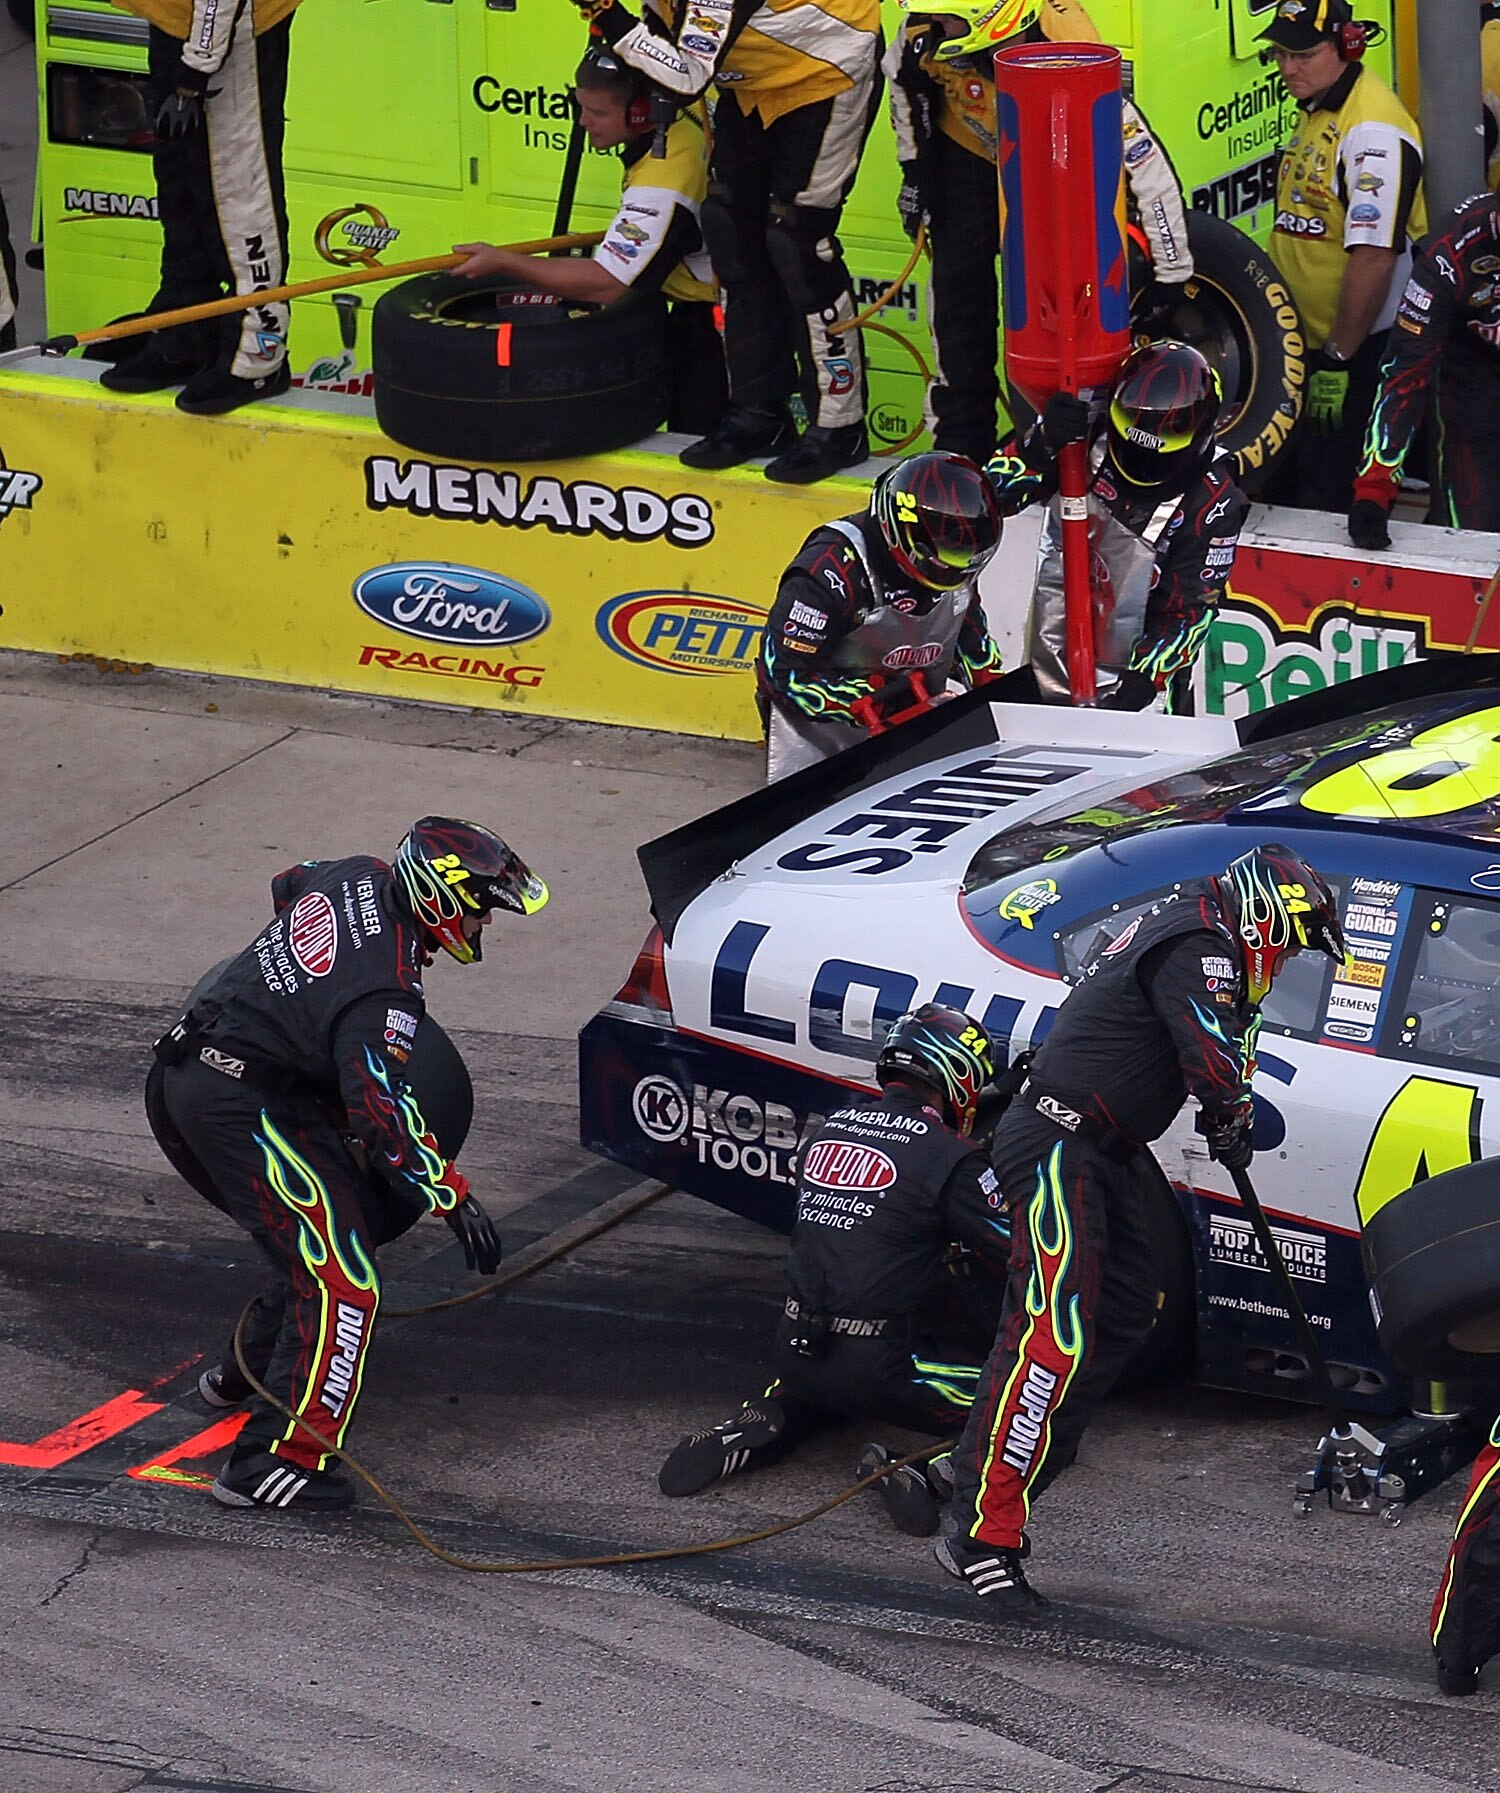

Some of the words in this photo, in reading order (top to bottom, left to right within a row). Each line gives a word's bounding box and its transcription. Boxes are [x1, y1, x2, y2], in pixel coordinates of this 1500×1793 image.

[341, 221, 401, 245] QUAKER
[347, 235, 389, 251] STATE
[244, 233, 282, 334] MEN
[877, 411, 908, 434] Serta
[368, 457, 715, 546] MENARDS
[896, 490, 919, 525] 24
[392, 572, 512, 636] Ford
[688, 607, 749, 624] RICHARD
[789, 608, 829, 631] GUARD
[357, 644, 546, 688] RACING
[430, 852, 473, 886] 24
[1017, 882, 1062, 906] QUAKER
[1278, 884, 1312, 915] 24
[1351, 876, 1401, 897] Hendrick
[356, 875, 382, 937] VERMEER
[1012, 893, 1050, 913] STATE
[1346, 902, 1387, 918] NATIONAL
[293, 893, 334, 971] DUPONT
[1344, 912, 1397, 936] GUARD
[1350, 972, 1380, 986] BOSCH
[1353, 961, 1382, 975] BOSCH
[1329, 995, 1378, 1013] SIEMENS
[957, 1025, 990, 1058] 24
[823, 1121, 912, 1146] www.dupont.com
[811, 1190, 876, 1218] miracles
[801, 1204, 856, 1231] science
[1209, 1226, 1250, 1251] TOP
[1253, 1236, 1327, 1268] COICE
[1209, 1246, 1258, 1266] LUMBER
[314, 1301, 367, 1419] DUPONT
[1001, 1359, 1060, 1477] DUPONT
